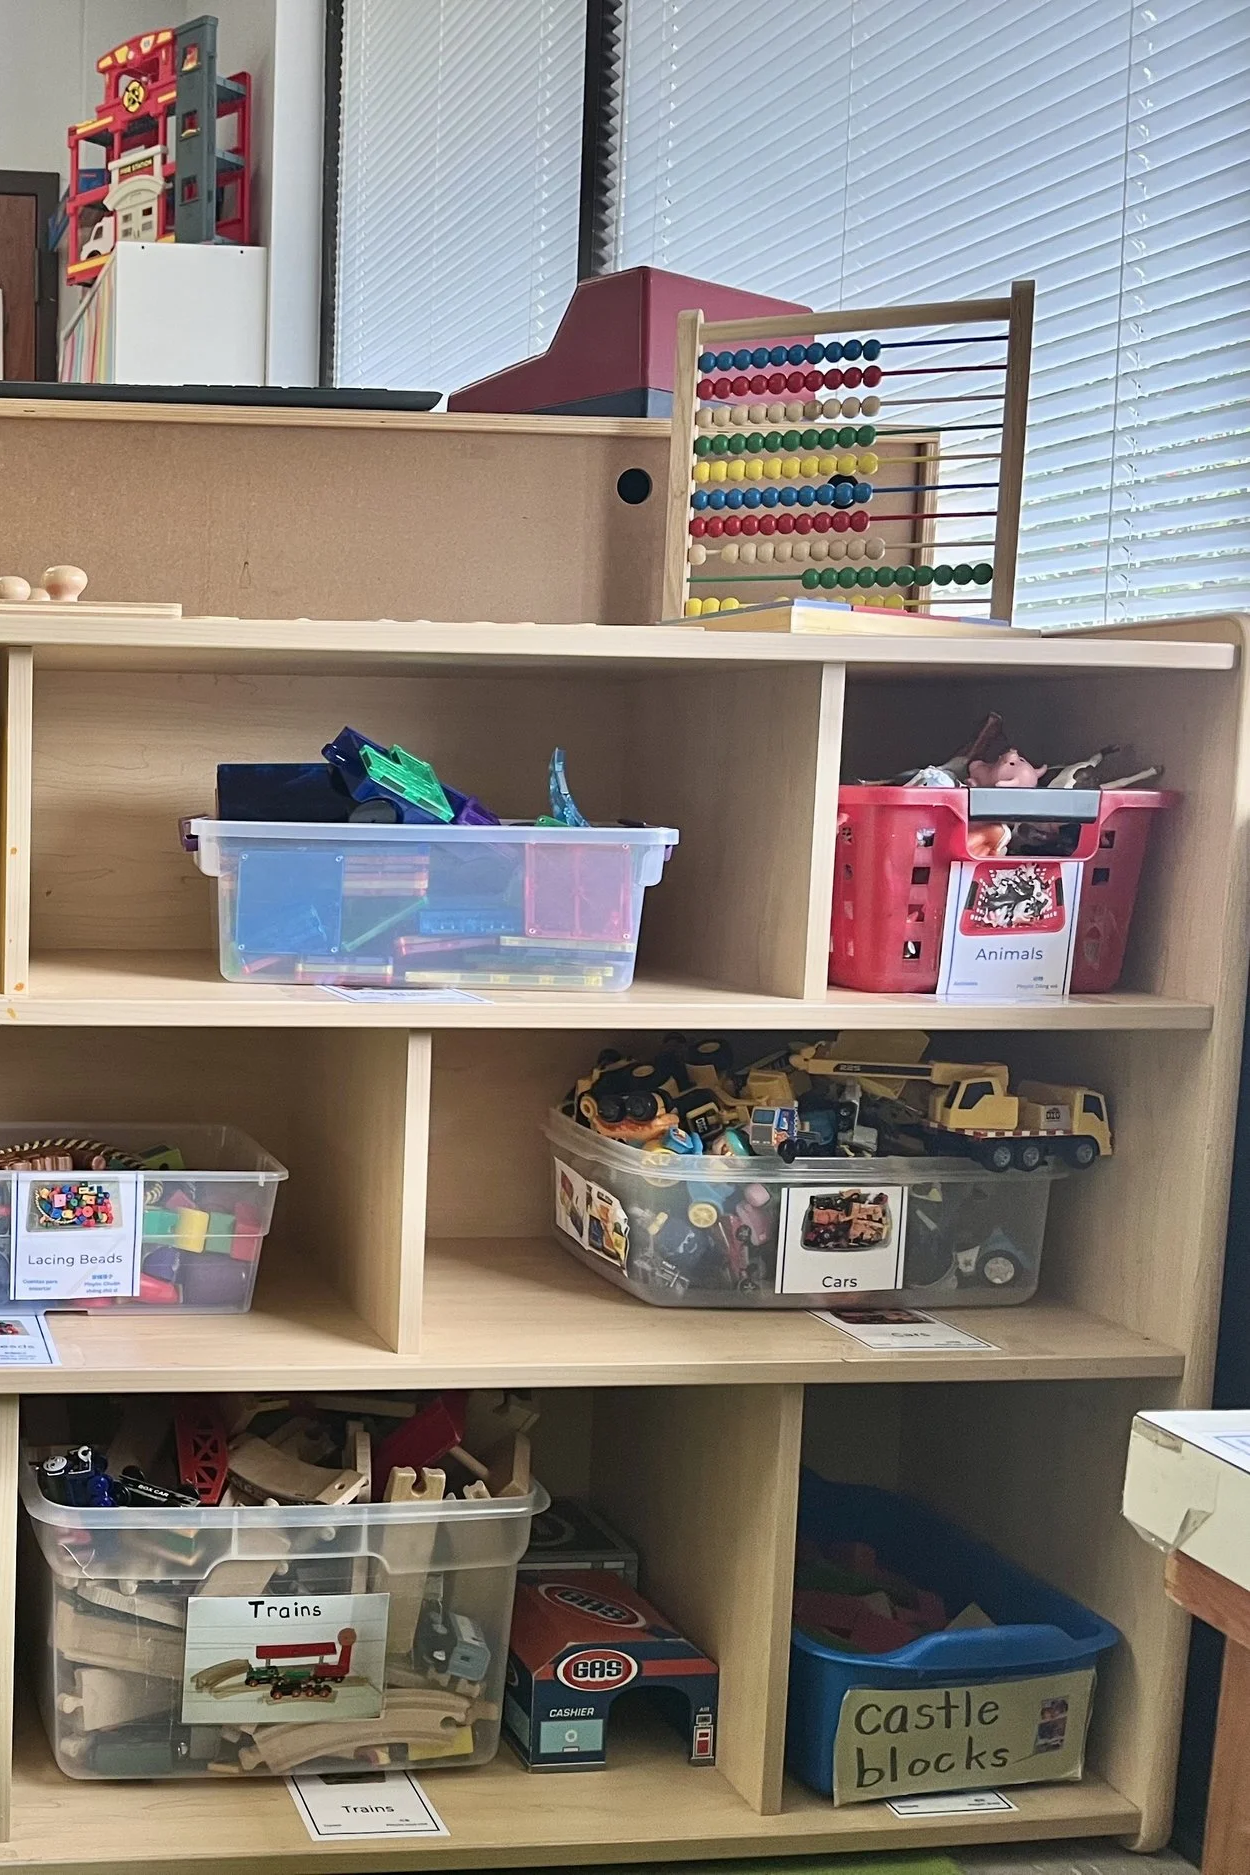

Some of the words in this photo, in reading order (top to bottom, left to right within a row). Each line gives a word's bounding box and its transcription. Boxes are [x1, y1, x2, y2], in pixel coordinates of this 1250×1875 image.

[975, 947, 1043, 960] Animals
[28, 1254, 75, 1267] Lacing
[80, 1253, 123, 1265] Beads
[822, 1276, 858, 1288] Cars
[138, 1484, 153, 1493] BOX
[153, 1489, 169, 1497] CAR
[248, 1601, 321, 1618] Trains
[557, 1589, 627, 1620] GAS
[572, 1659, 623, 1680] GAS
[549, 1707, 594, 1717] CASHIER
[854, 1690, 999, 1735] castle
[856, 1735, 1010, 1788] blocks
[342, 1805, 394, 1814] Trains
